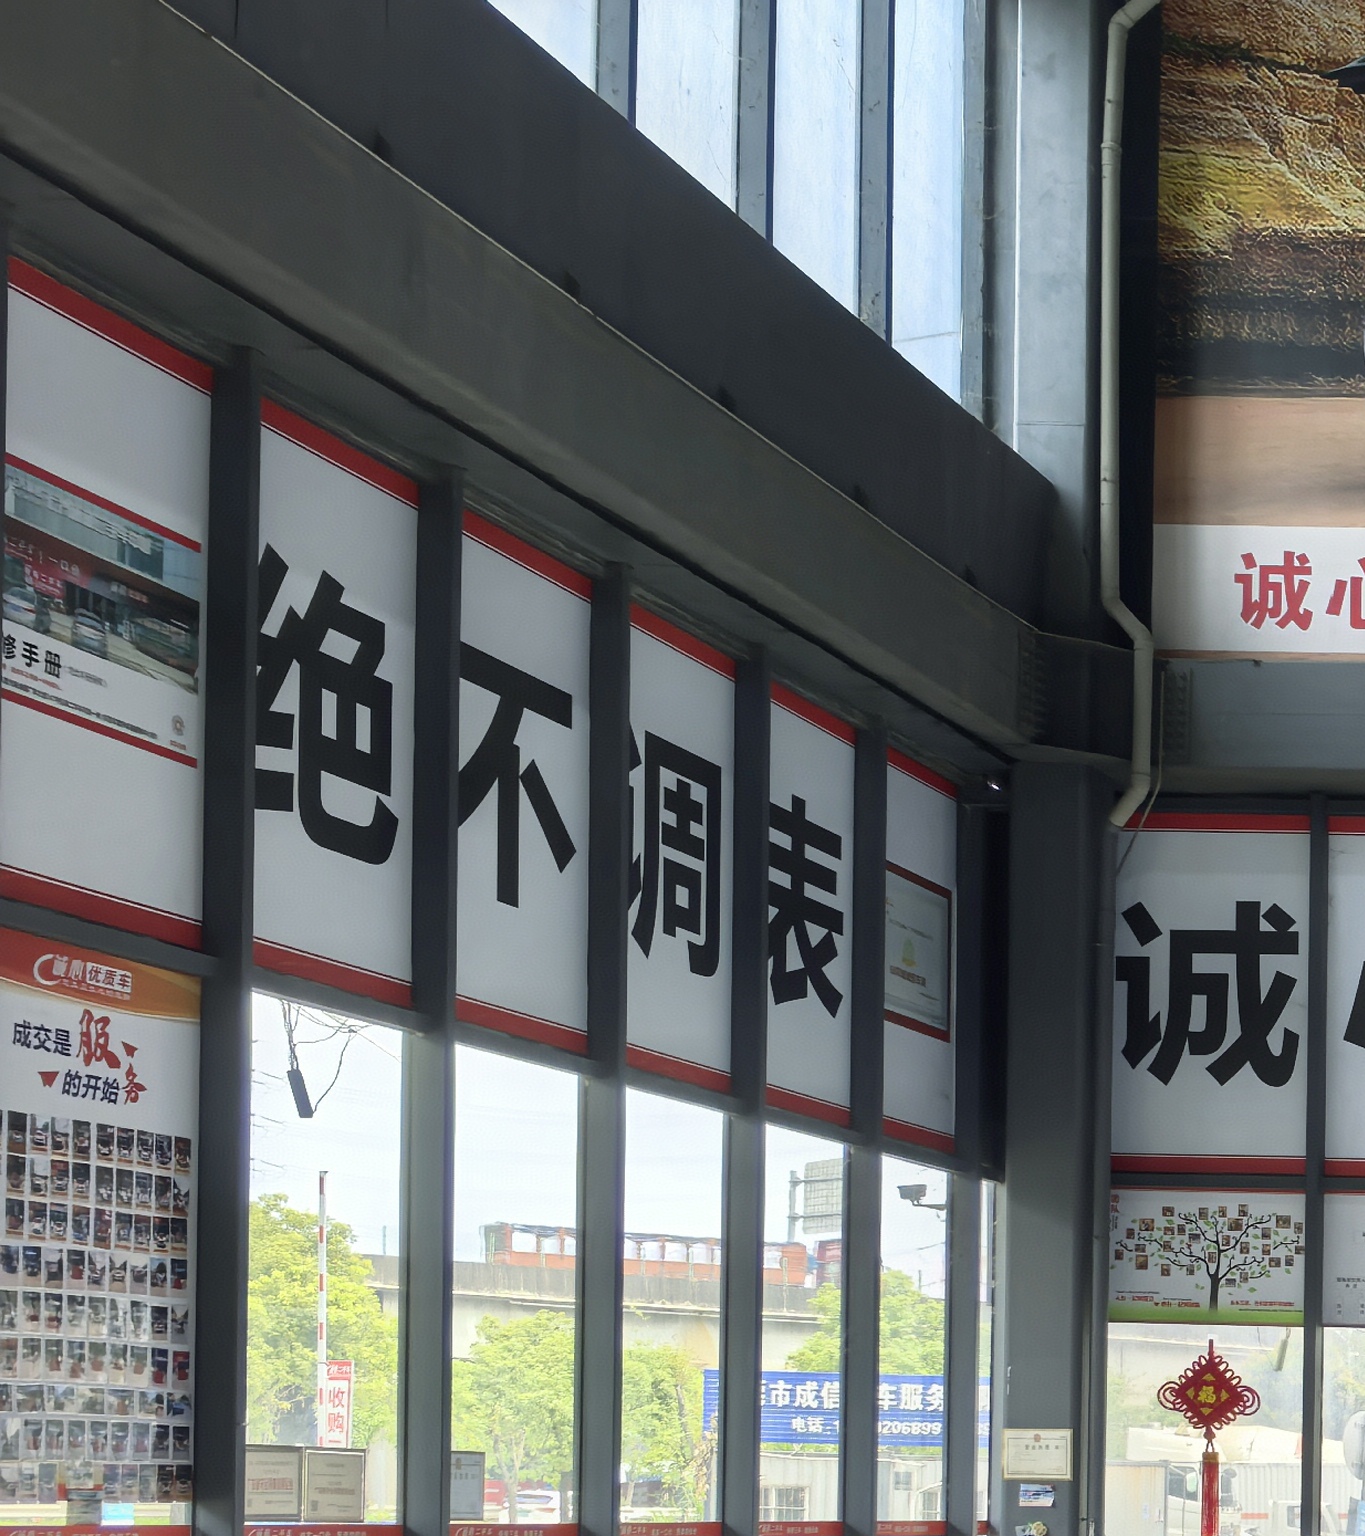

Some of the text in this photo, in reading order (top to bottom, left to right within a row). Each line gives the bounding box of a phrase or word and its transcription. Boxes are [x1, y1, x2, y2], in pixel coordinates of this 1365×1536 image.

[87, 964, 131, 990] 优质车
[12, 1020, 72, 1056] 成交是
[62, 1069, 119, 1105] 的开始
